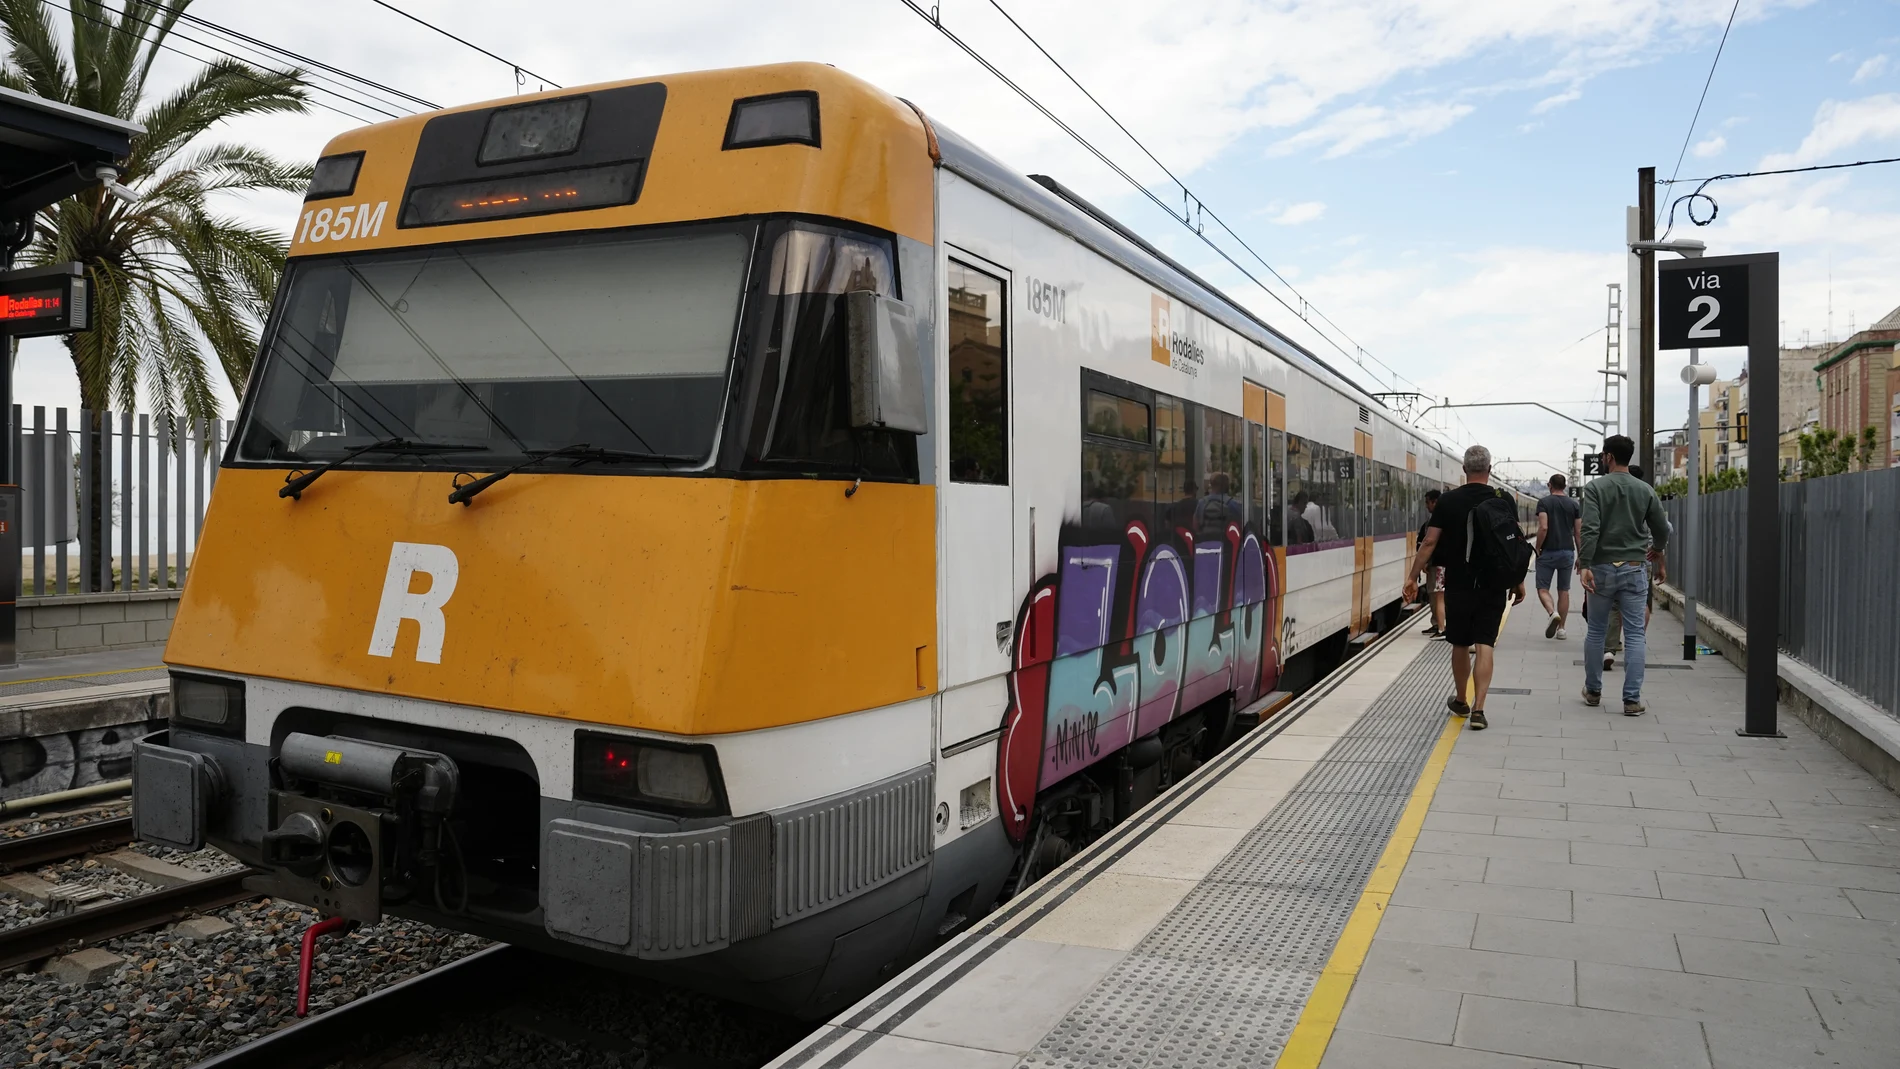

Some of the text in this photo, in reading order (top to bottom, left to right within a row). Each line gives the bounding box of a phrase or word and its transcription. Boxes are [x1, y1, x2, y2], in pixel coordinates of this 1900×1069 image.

[299, 201, 388, 243] 185M
[1025, 275, 1066, 324] 185M
[1687, 271, 1721, 290] via
[1688, 295, 1721, 339] 2
[1172, 330, 1205, 366] Rodalies
[1171, 356, 1198, 380] de Catalunya
[1590, 462, 1599, 474] 2
[367, 541, 459, 665] R
